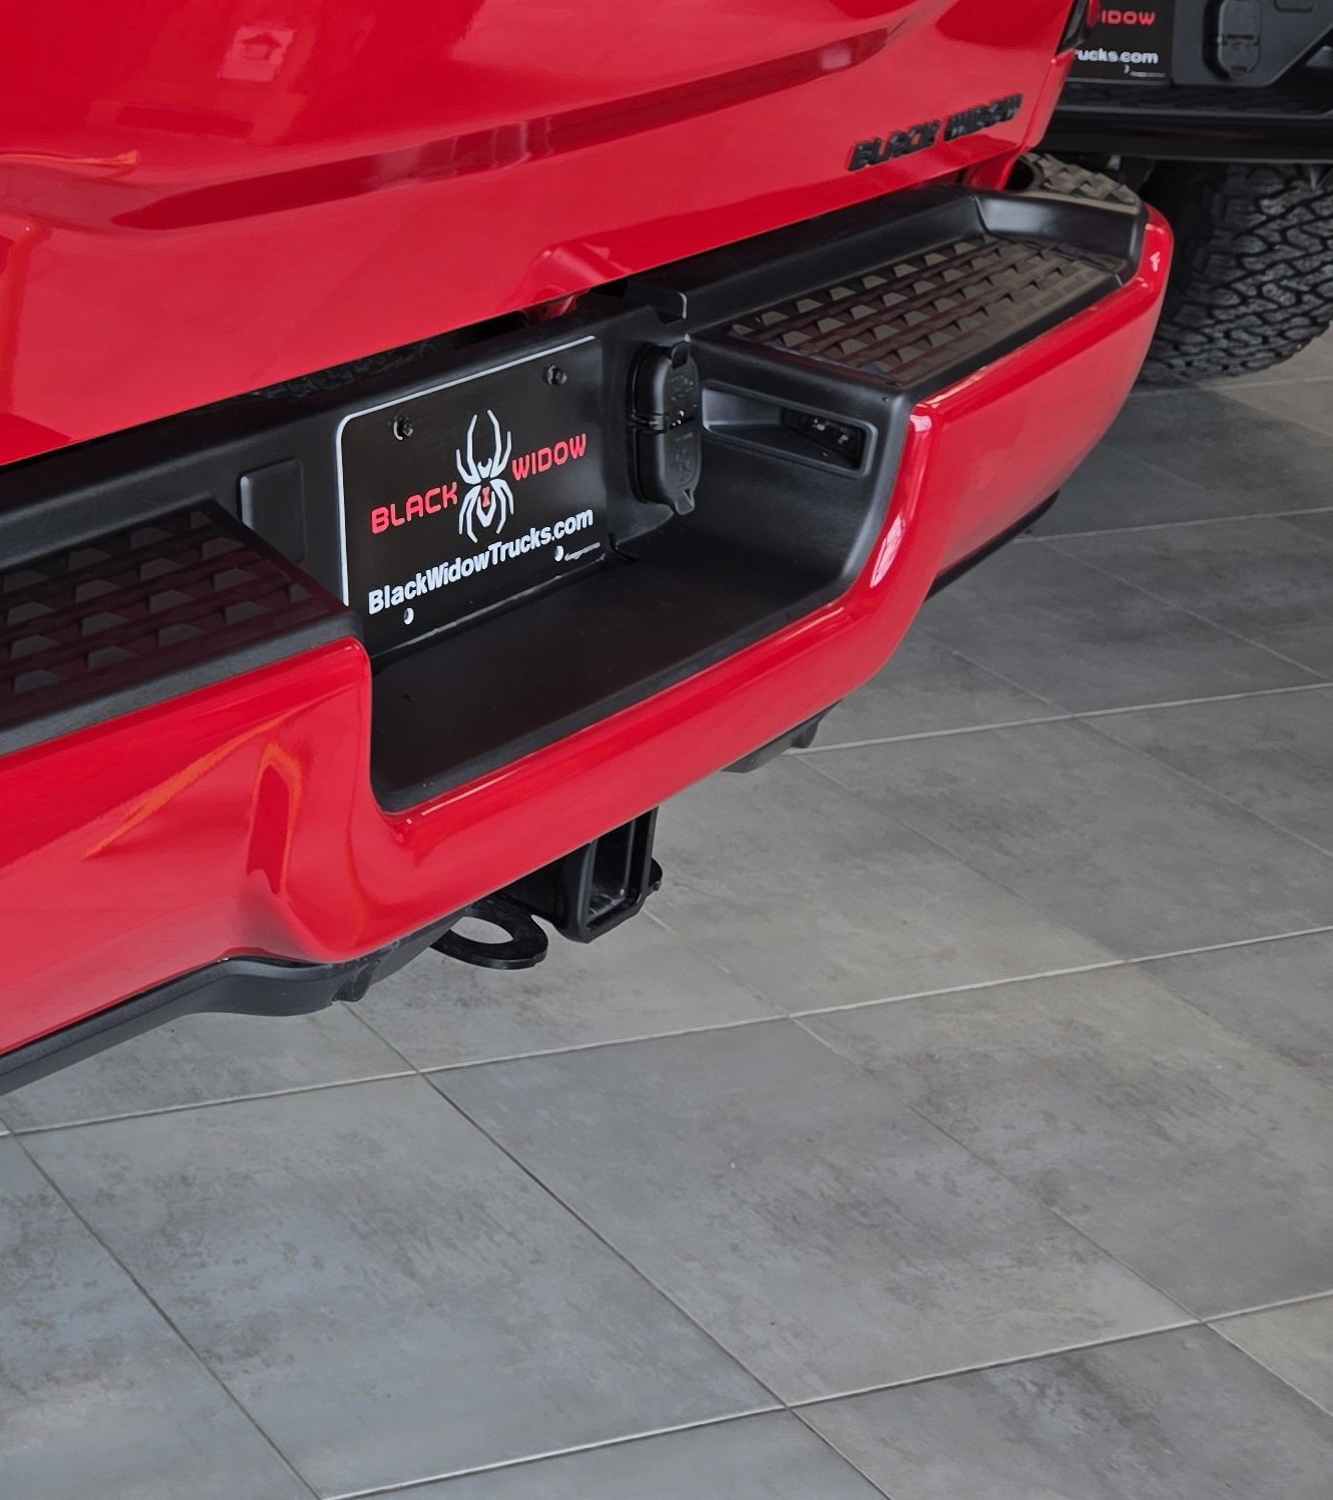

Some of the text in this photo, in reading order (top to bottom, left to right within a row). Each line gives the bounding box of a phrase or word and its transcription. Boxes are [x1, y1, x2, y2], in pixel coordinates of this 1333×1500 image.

[1100, 10, 1156, 26] IDOW
[848, 119, 941, 171] BLACK
[370, 433, 588, 534] BLACK WIDOW
[367, 508, 594, 615] BlackWidowTrucks.com
